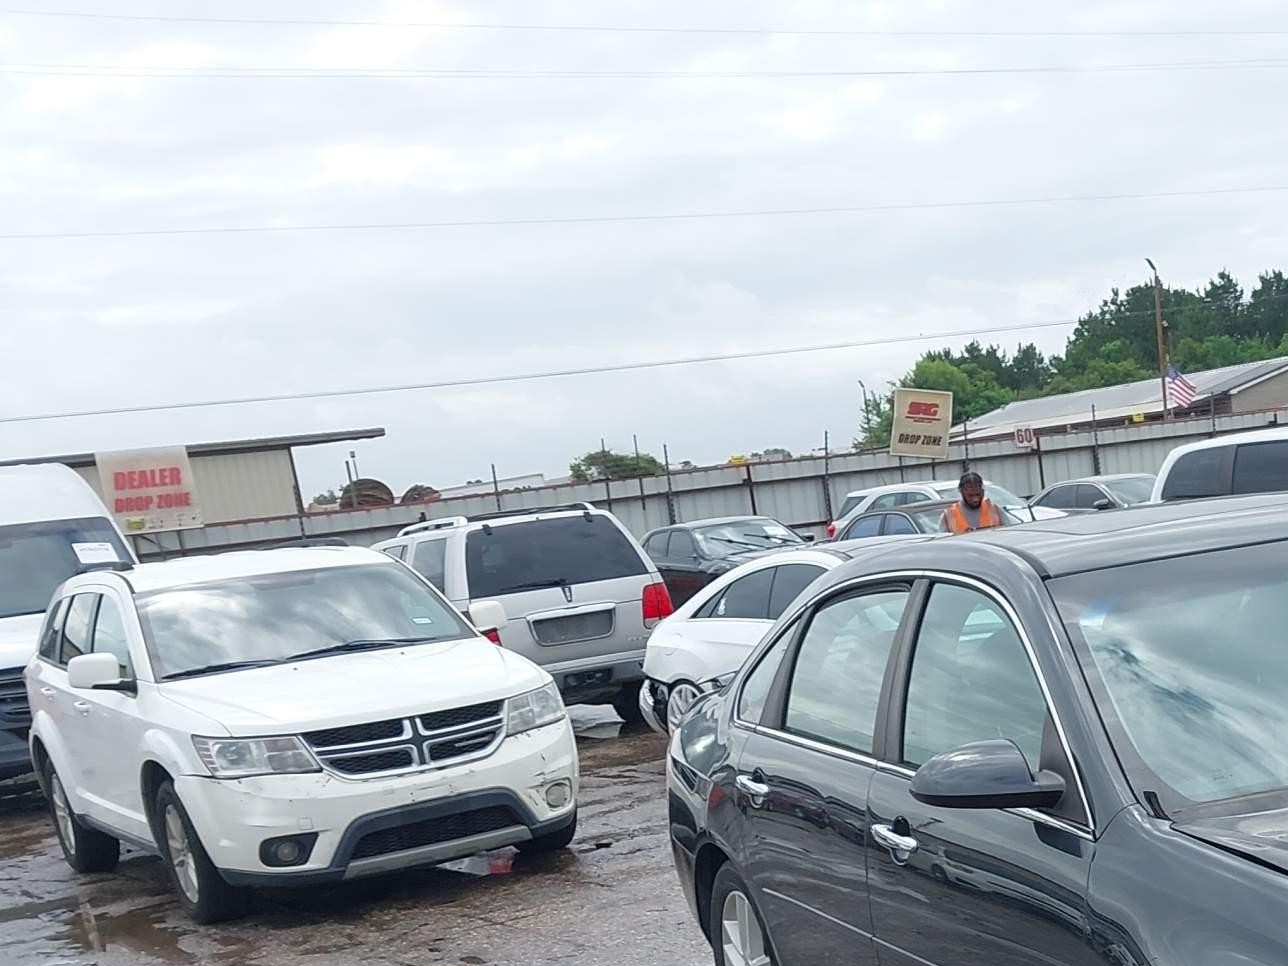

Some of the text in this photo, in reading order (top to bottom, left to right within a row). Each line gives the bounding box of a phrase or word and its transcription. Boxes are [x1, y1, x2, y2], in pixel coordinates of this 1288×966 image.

[898, 433, 942, 446] DROP ZONE
[1016, 428, 1033, 444] 60
[113, 466, 182, 491] DEALER
[114, 491, 192, 513] DROP ZONE
